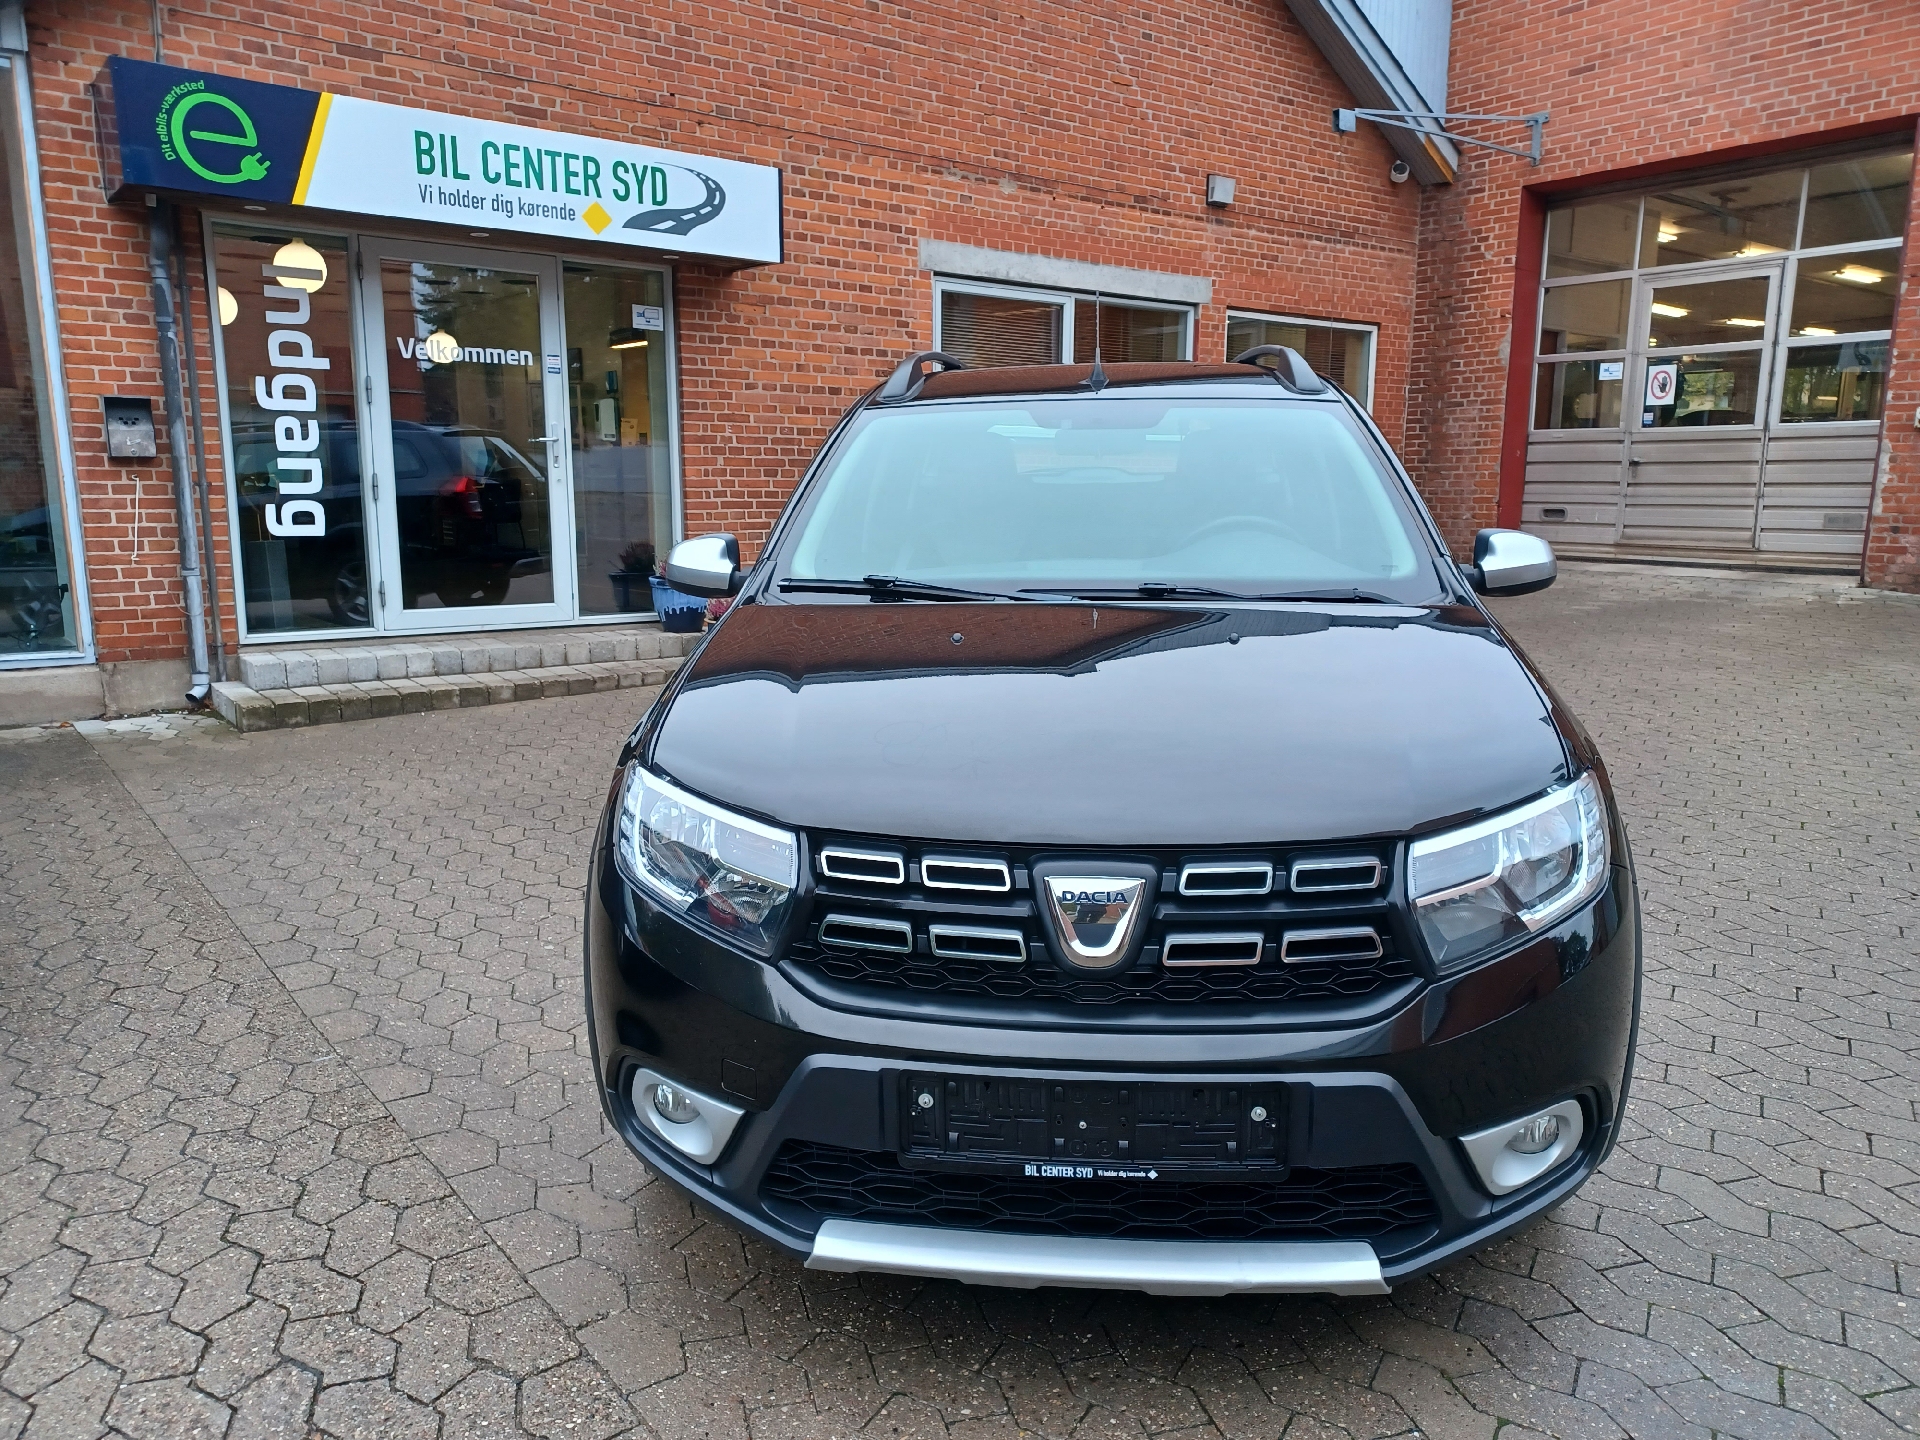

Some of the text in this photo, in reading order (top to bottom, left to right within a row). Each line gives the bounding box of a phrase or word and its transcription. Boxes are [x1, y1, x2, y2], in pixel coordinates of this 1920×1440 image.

[161, 143, 177, 161] Dit
[414, 130, 668, 207] BIL CENTER SYD
[418, 183, 577, 222] Vi holder dig kørende
[396, 336, 534, 366] Velkommen
[255, 263, 331, 537] Indgang
[1062, 890, 1128, 904] DACIA
[1025, 1165, 1093, 1179] BIL CENTER SYD
